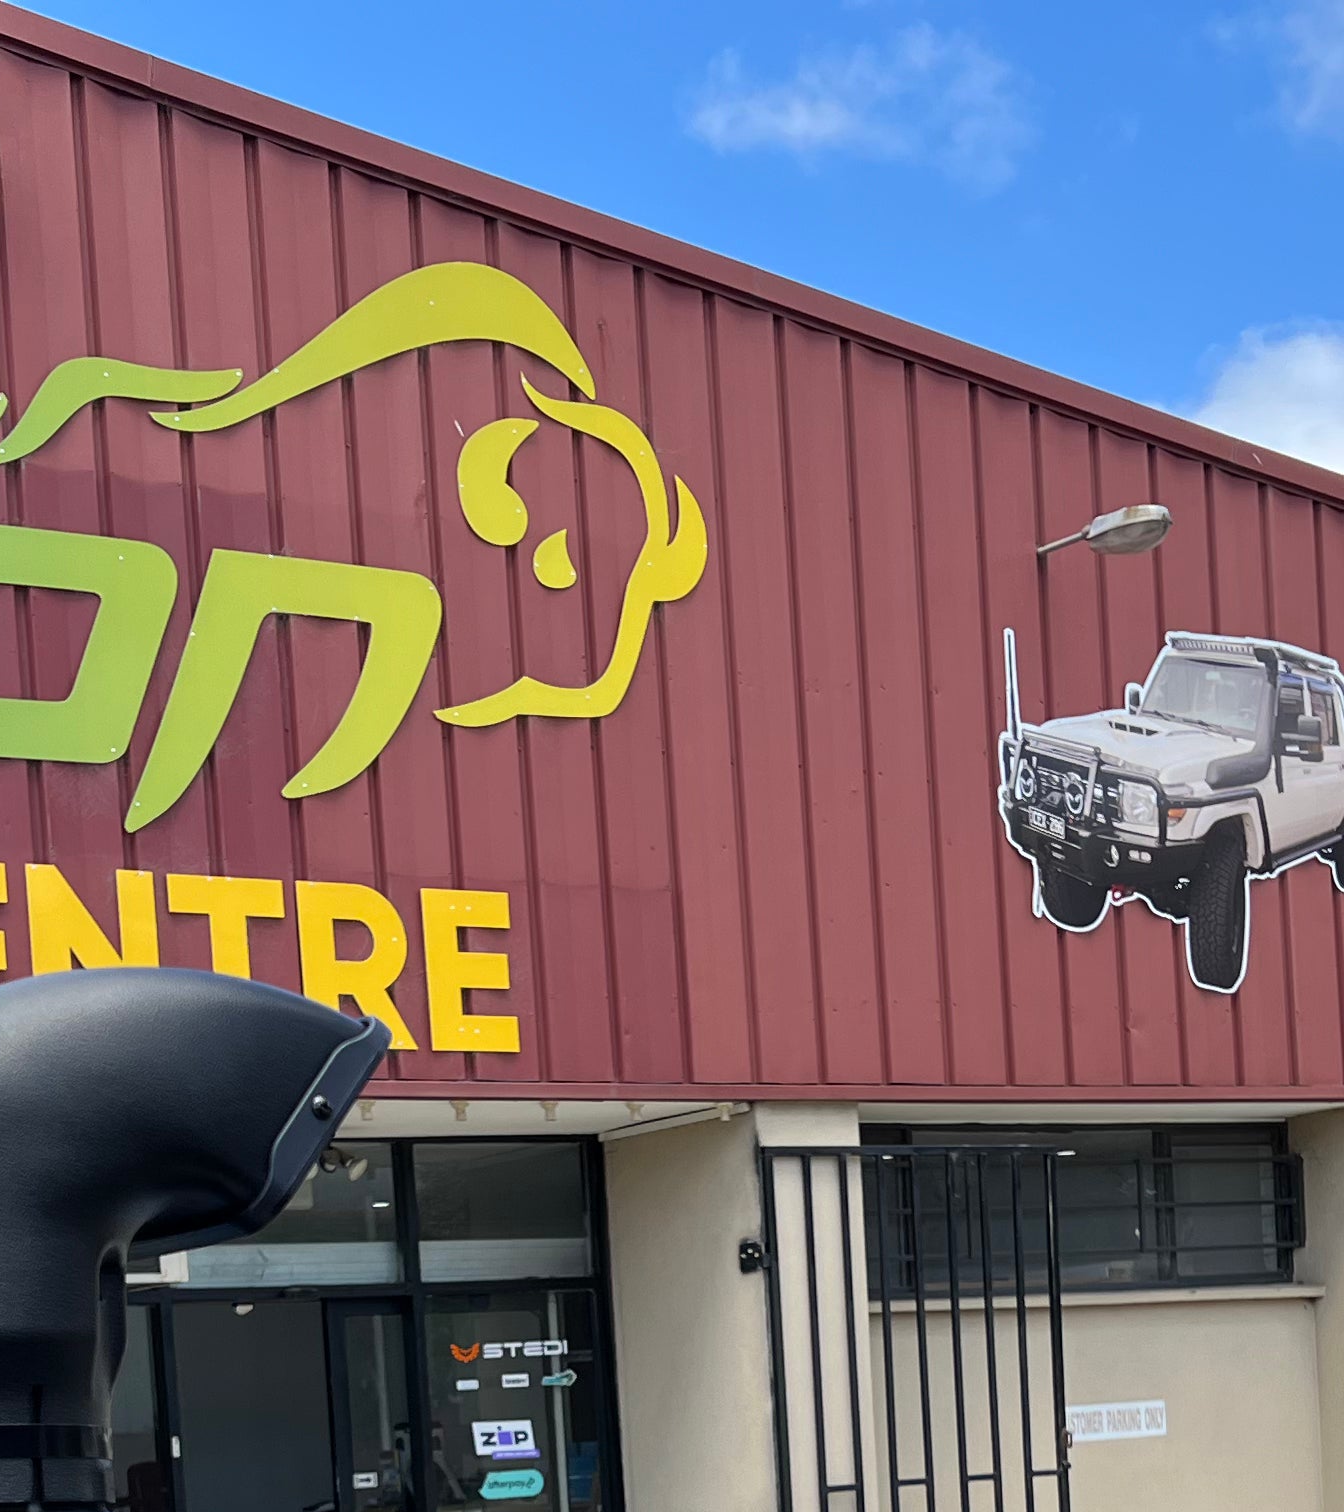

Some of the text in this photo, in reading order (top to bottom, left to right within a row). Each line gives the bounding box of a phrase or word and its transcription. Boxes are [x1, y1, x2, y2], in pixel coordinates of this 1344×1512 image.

[483, 1339, 568, 1359] STEDI
[1106, 1407, 1142, 1433] PARKING
[1144, 1406, 1164, 1431] ONLY
